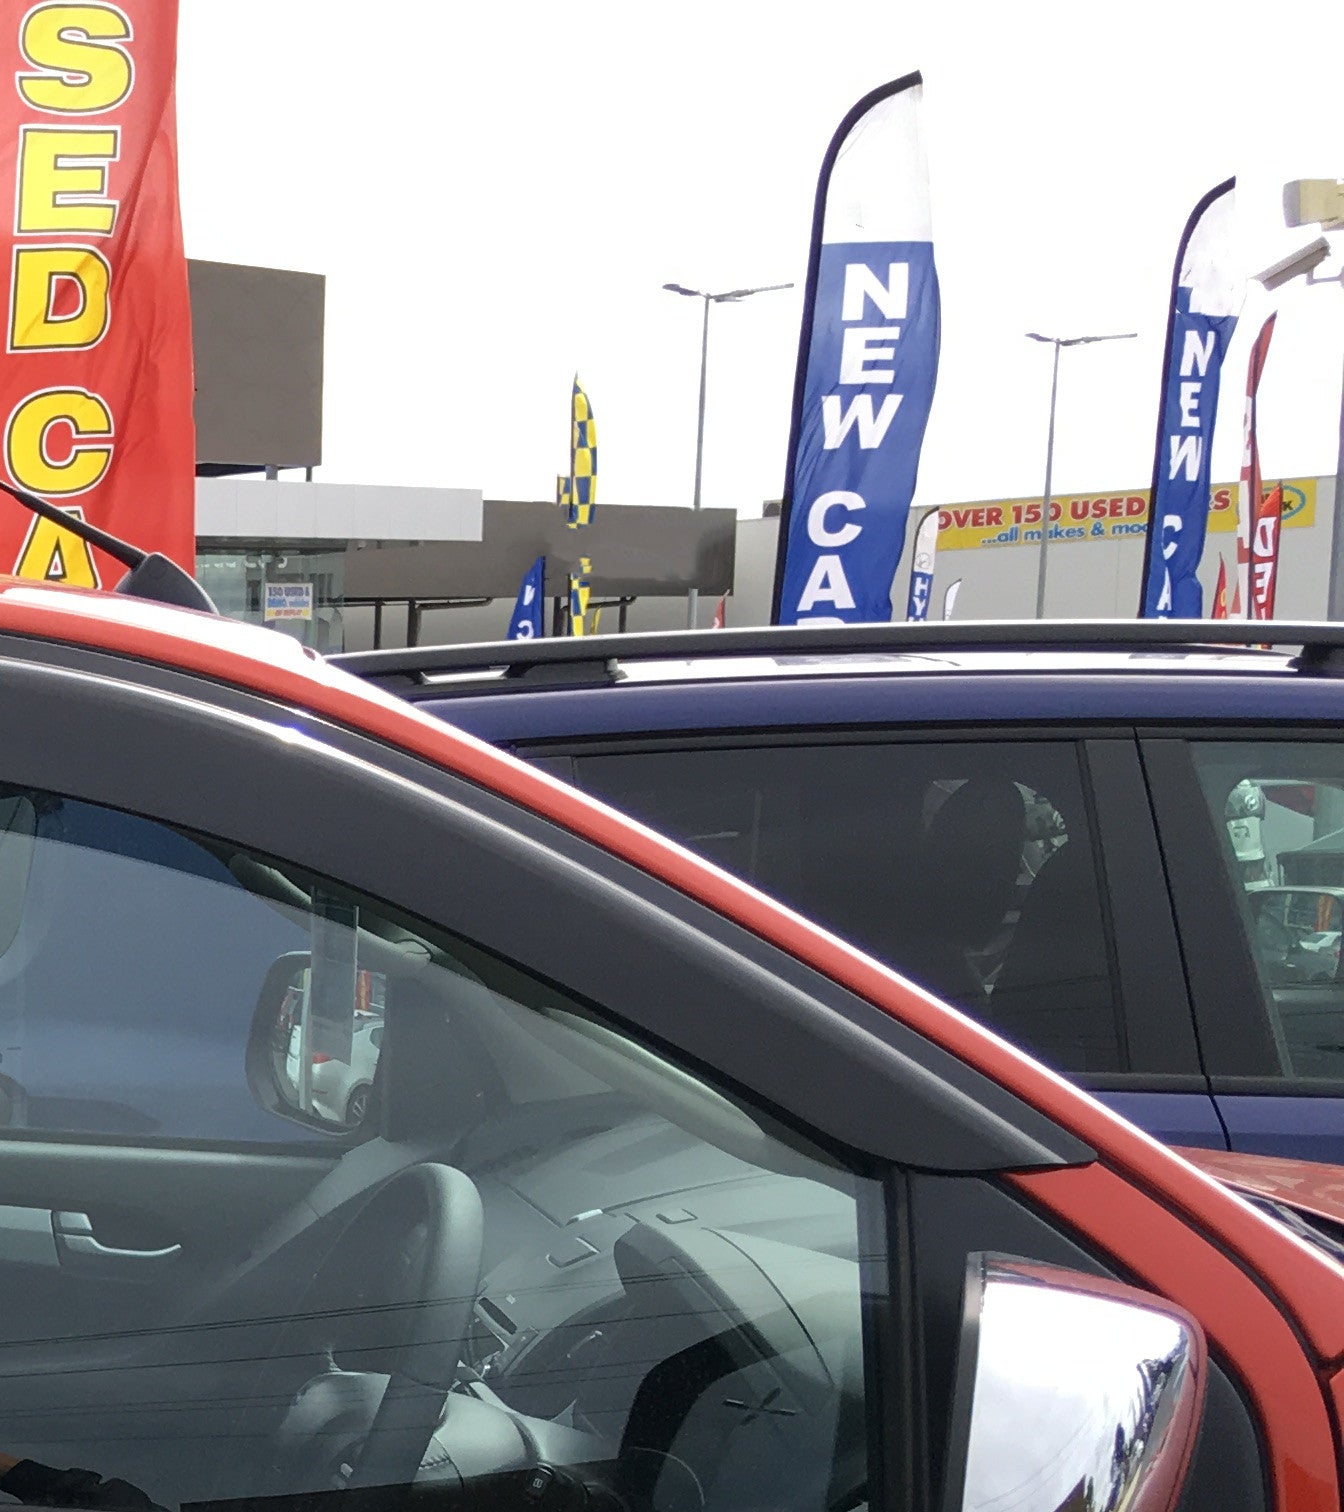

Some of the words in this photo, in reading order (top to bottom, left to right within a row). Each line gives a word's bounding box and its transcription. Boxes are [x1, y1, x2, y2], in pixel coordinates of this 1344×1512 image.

[5, 0, 135, 353] SED
[822, 262, 910, 450] NEW
[1169, 330, 1216, 482] NEW
[796, 491, 867, 623] CA
[937, 507, 1004, 530] OVER
[1070, 496, 1146, 520] USED
[1090, 521, 1105, 536] &
[1156, 514, 1183, 618] CA
[908, 576, 929, 621] HY
